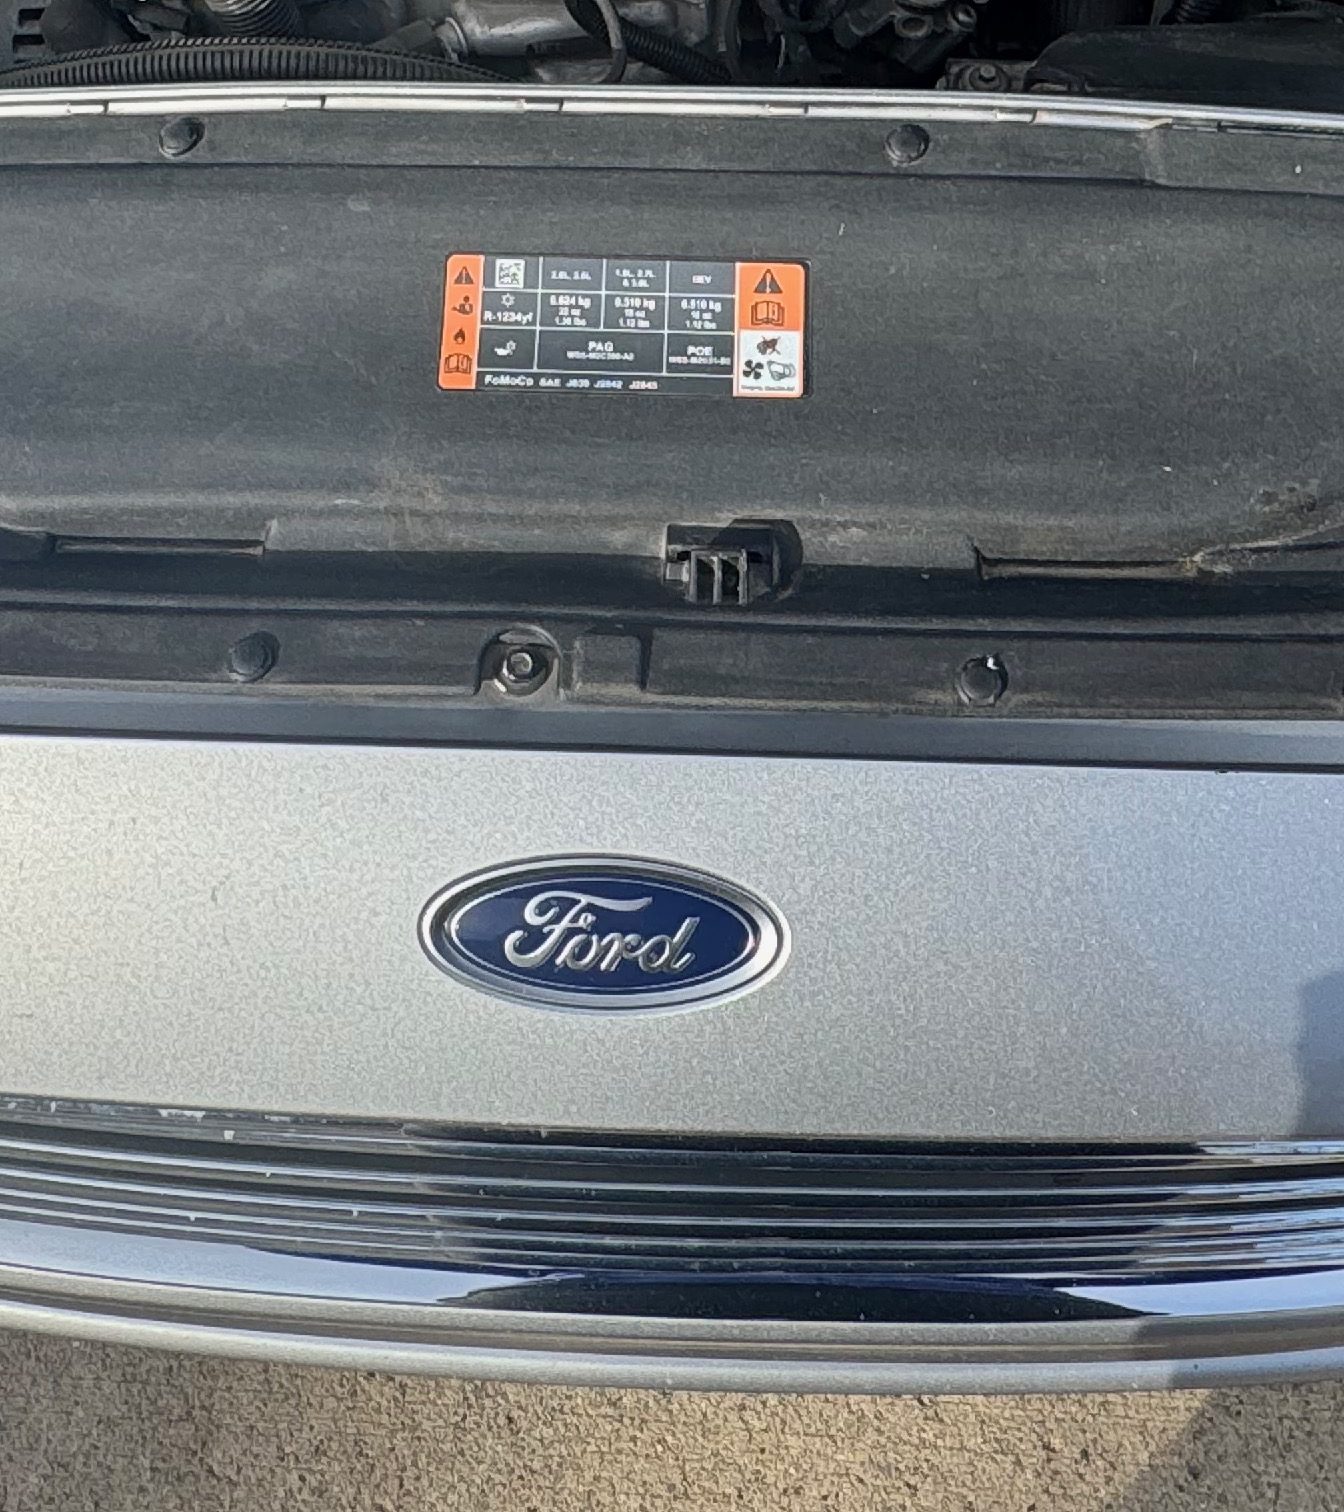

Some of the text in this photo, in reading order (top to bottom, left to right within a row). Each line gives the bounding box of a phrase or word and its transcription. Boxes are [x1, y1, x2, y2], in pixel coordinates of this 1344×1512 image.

[483, 310, 534, 326] R-1234yf
[587, 340, 614, 352] PAG
[686, 345, 714, 356] POE
[484, 374, 534, 386] FoMoCo
[538, 377, 562, 388] SAE
[503, 889, 702, 974] Ford
